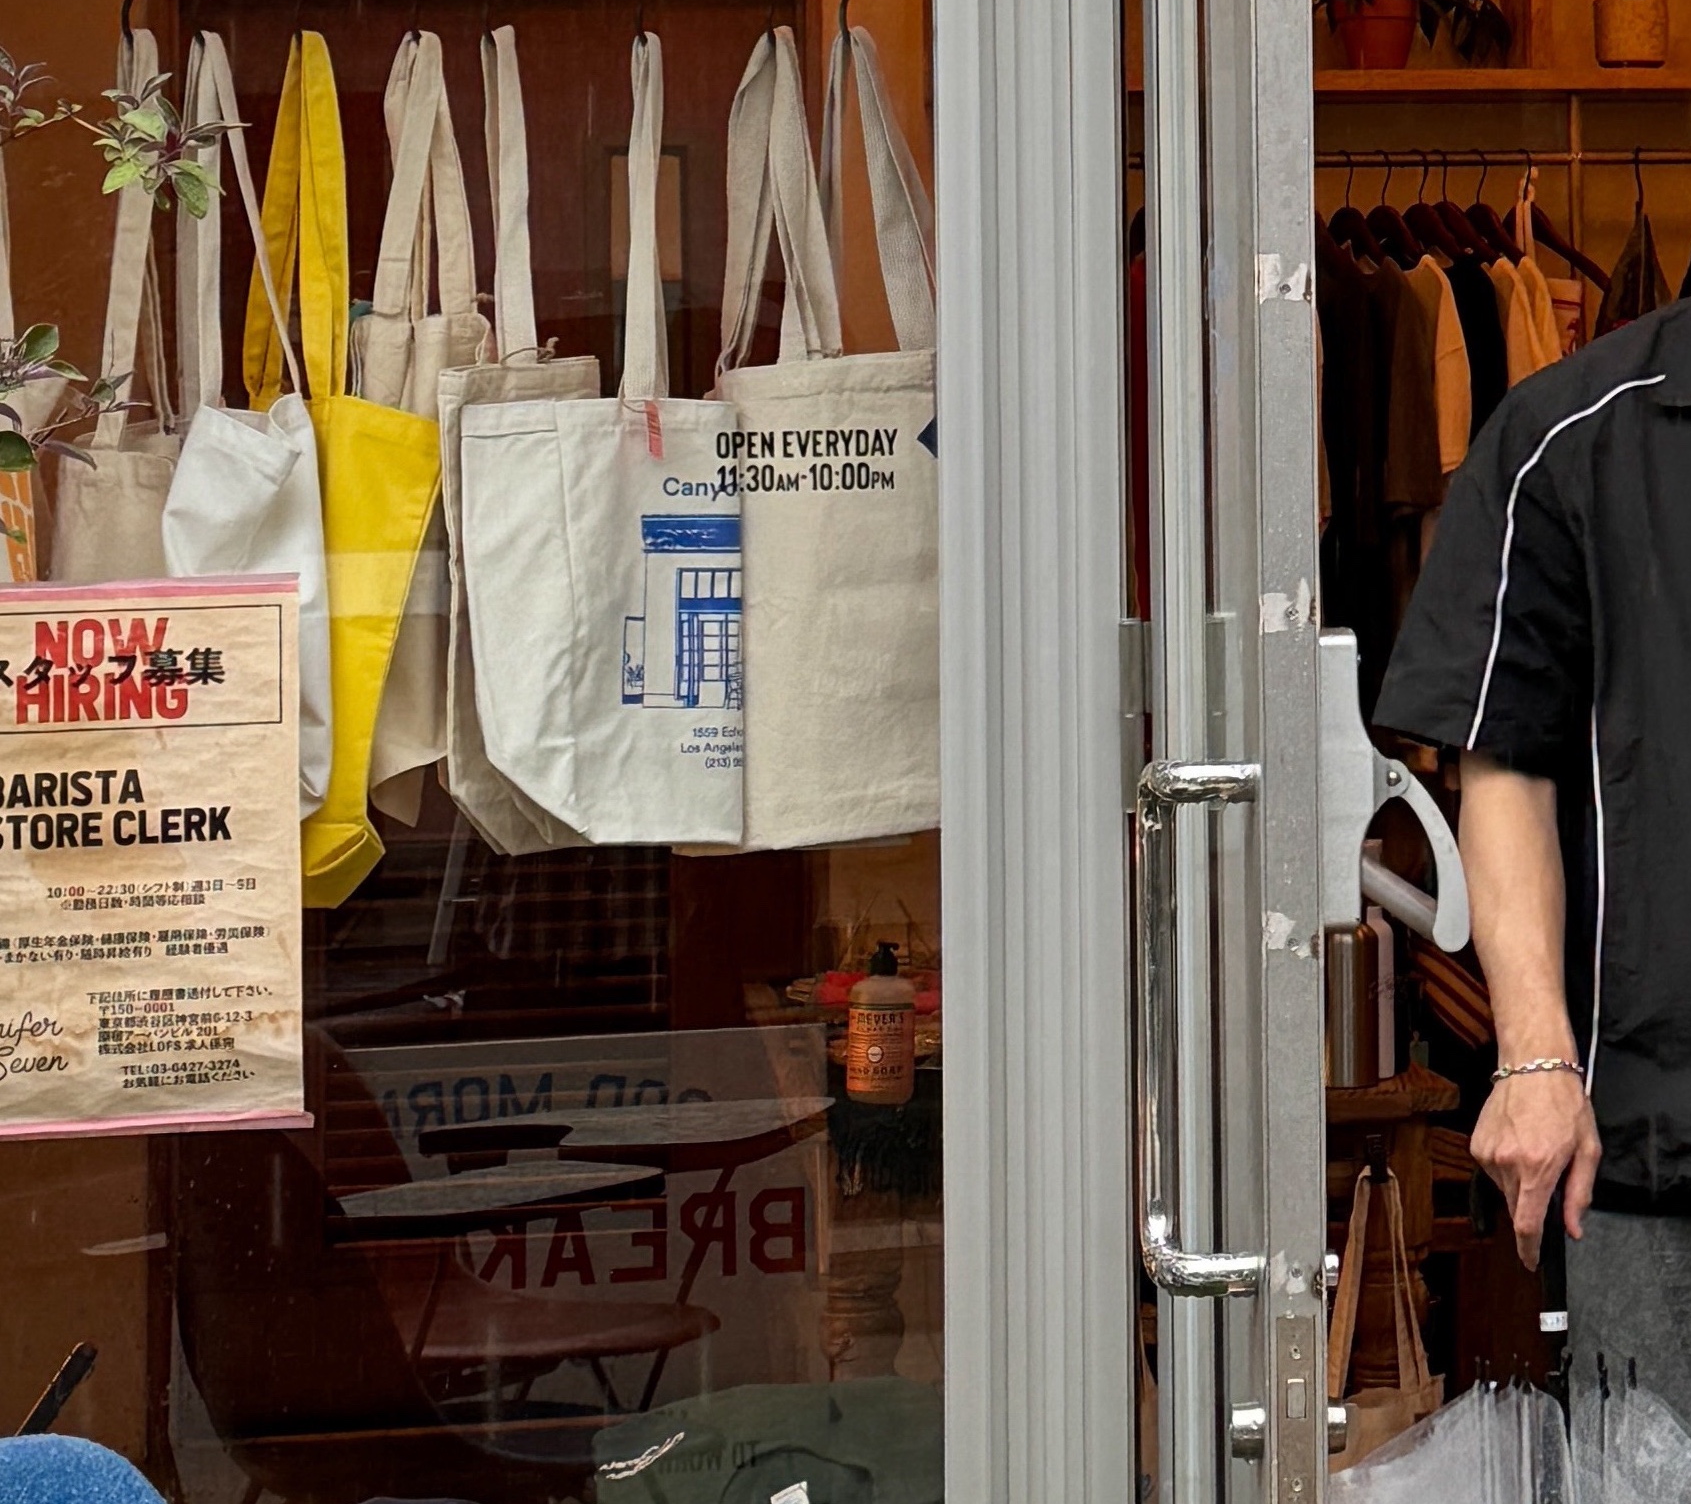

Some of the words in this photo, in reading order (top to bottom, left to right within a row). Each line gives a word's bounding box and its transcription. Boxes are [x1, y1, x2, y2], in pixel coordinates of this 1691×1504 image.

[716, 430, 775, 459] OPEN
[782, 428, 898, 458] EVERYDAY
[35, 617, 169, 669] NOW
[16, 671, 189, 725] HIRING
[680, 742, 701, 754] Los
[0, 769, 144, 810] ARISTA
[0, 811, 103, 850] TORE
[112, 806, 232, 847] CLERK
[196, 1025, 219, 1038] 201
